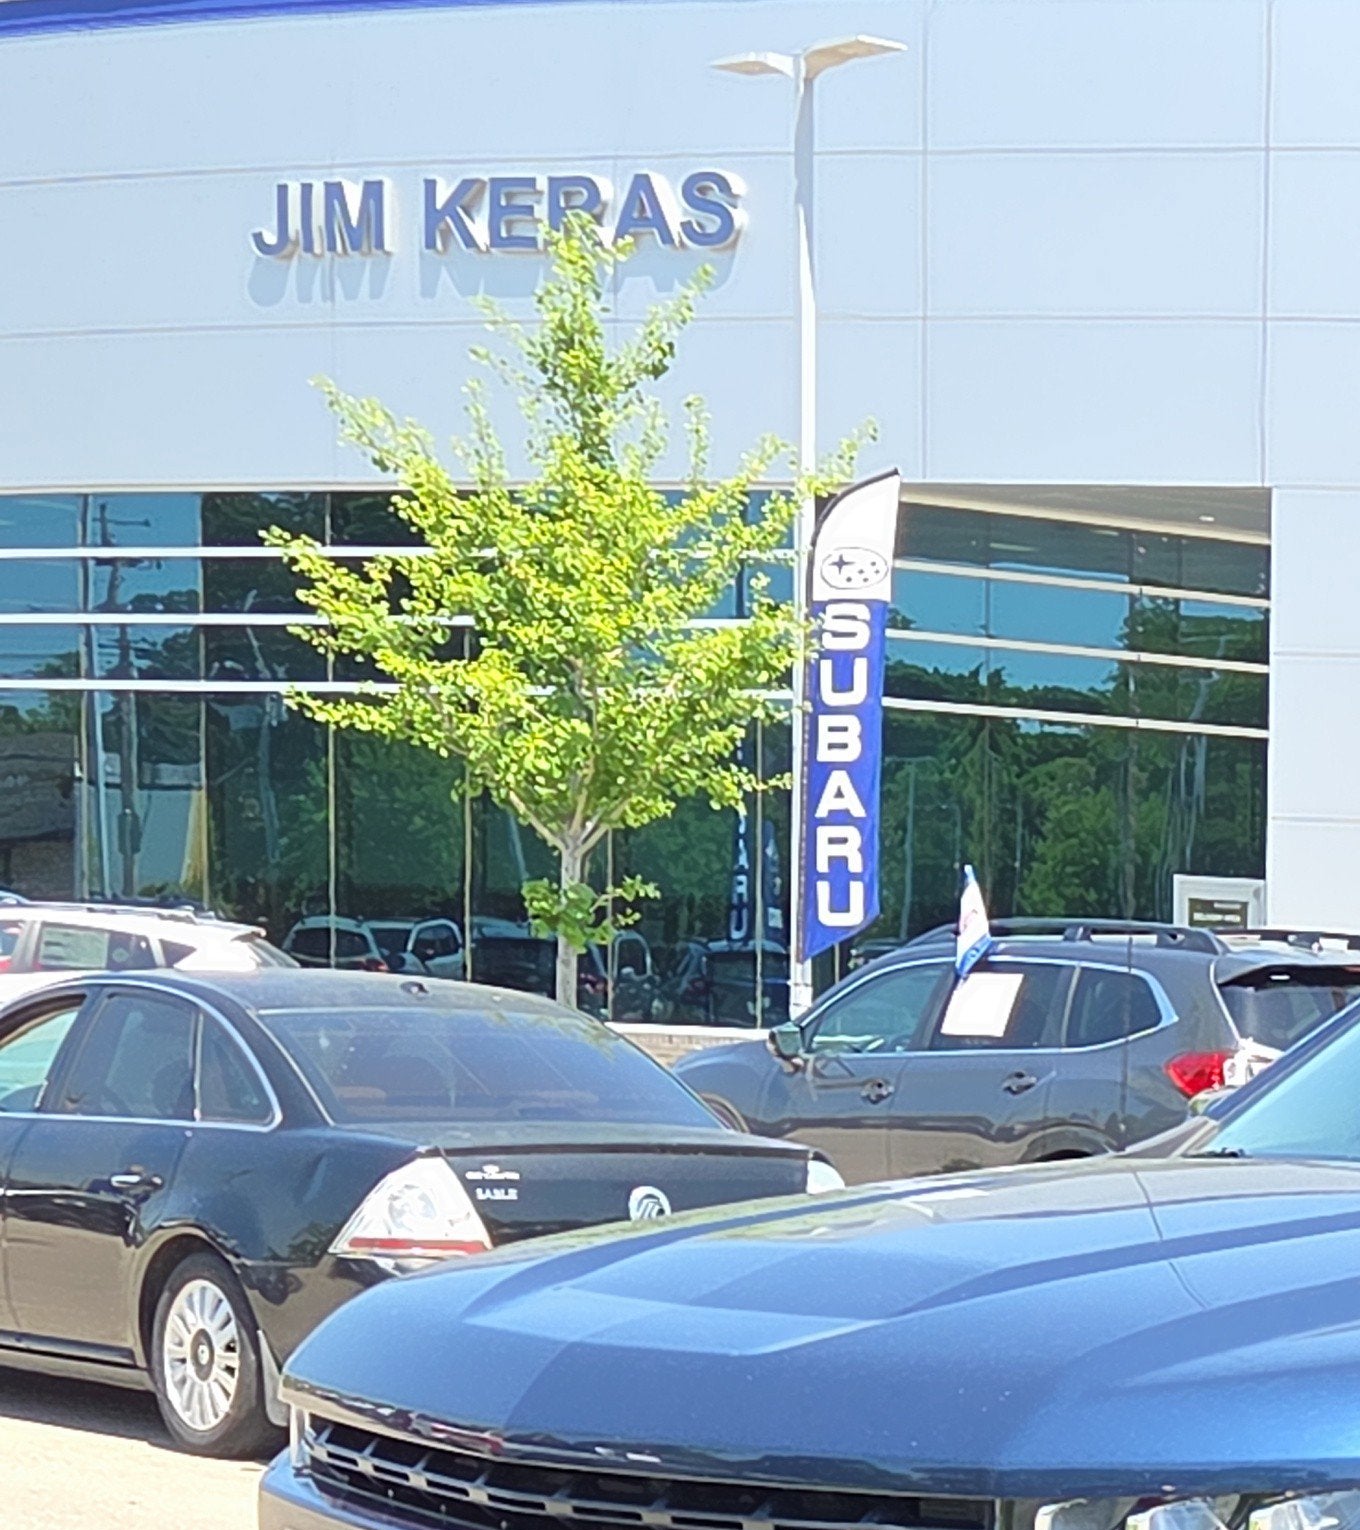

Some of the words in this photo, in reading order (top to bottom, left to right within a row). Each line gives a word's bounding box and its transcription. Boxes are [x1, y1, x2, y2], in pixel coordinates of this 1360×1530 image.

[252, 178, 390, 257] JIM
[422, 171, 739, 253] KERAS
[815, 602, 872, 927] SUBARU
